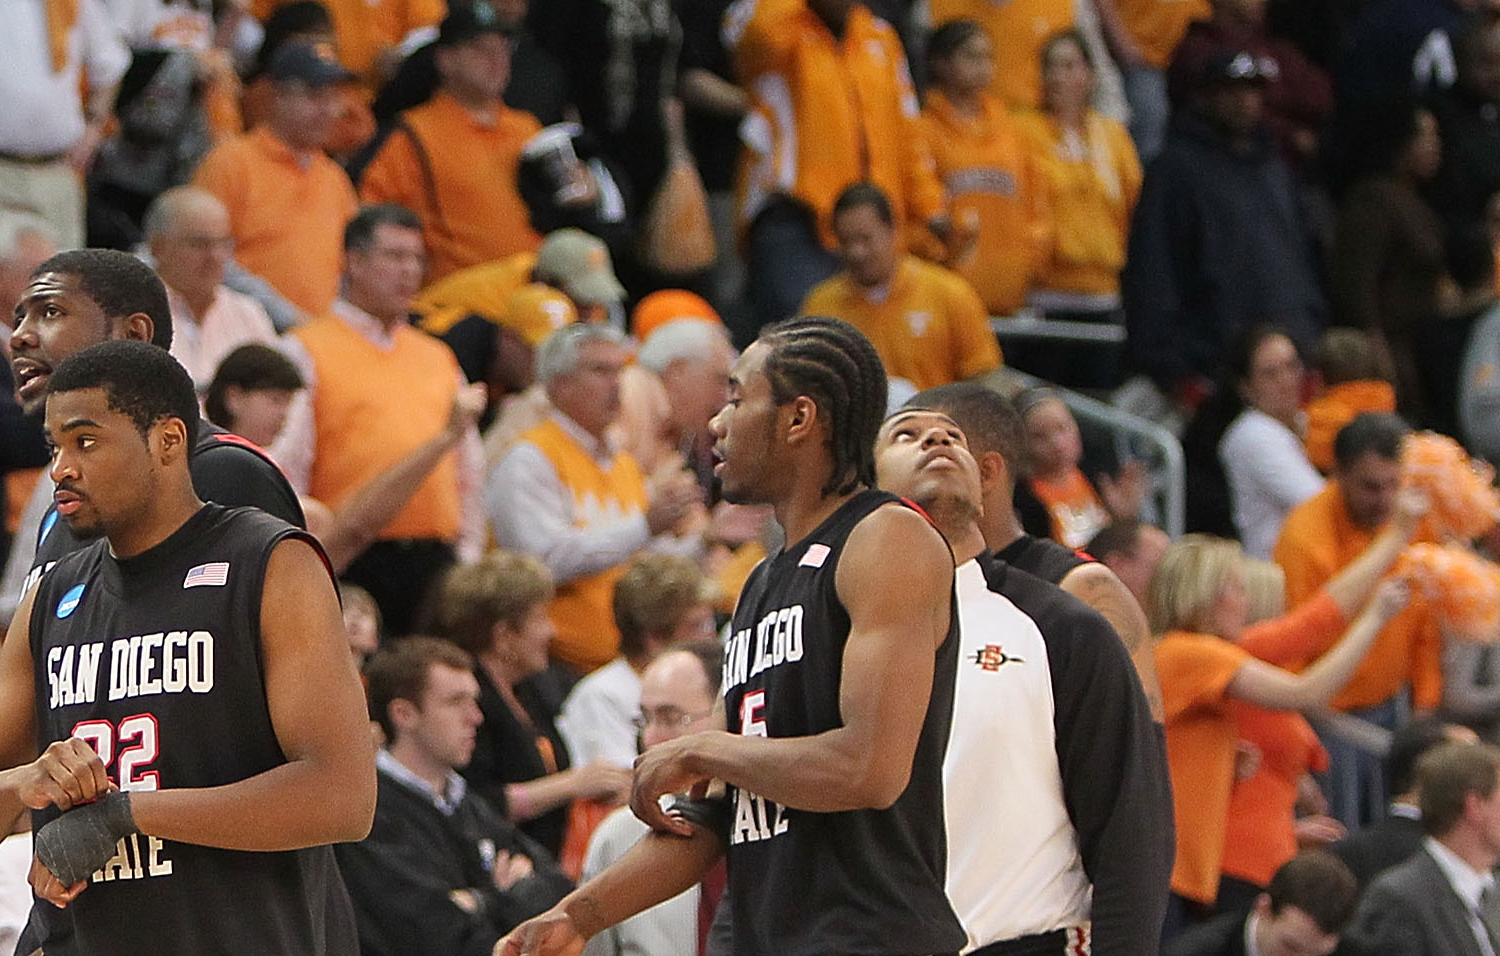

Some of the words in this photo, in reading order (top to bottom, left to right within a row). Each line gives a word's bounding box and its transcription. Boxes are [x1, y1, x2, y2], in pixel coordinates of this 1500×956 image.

[48, 643, 104, 709] SAN
[109, 631, 214, 701] DIEGO
[71, 712, 160, 792] 22
